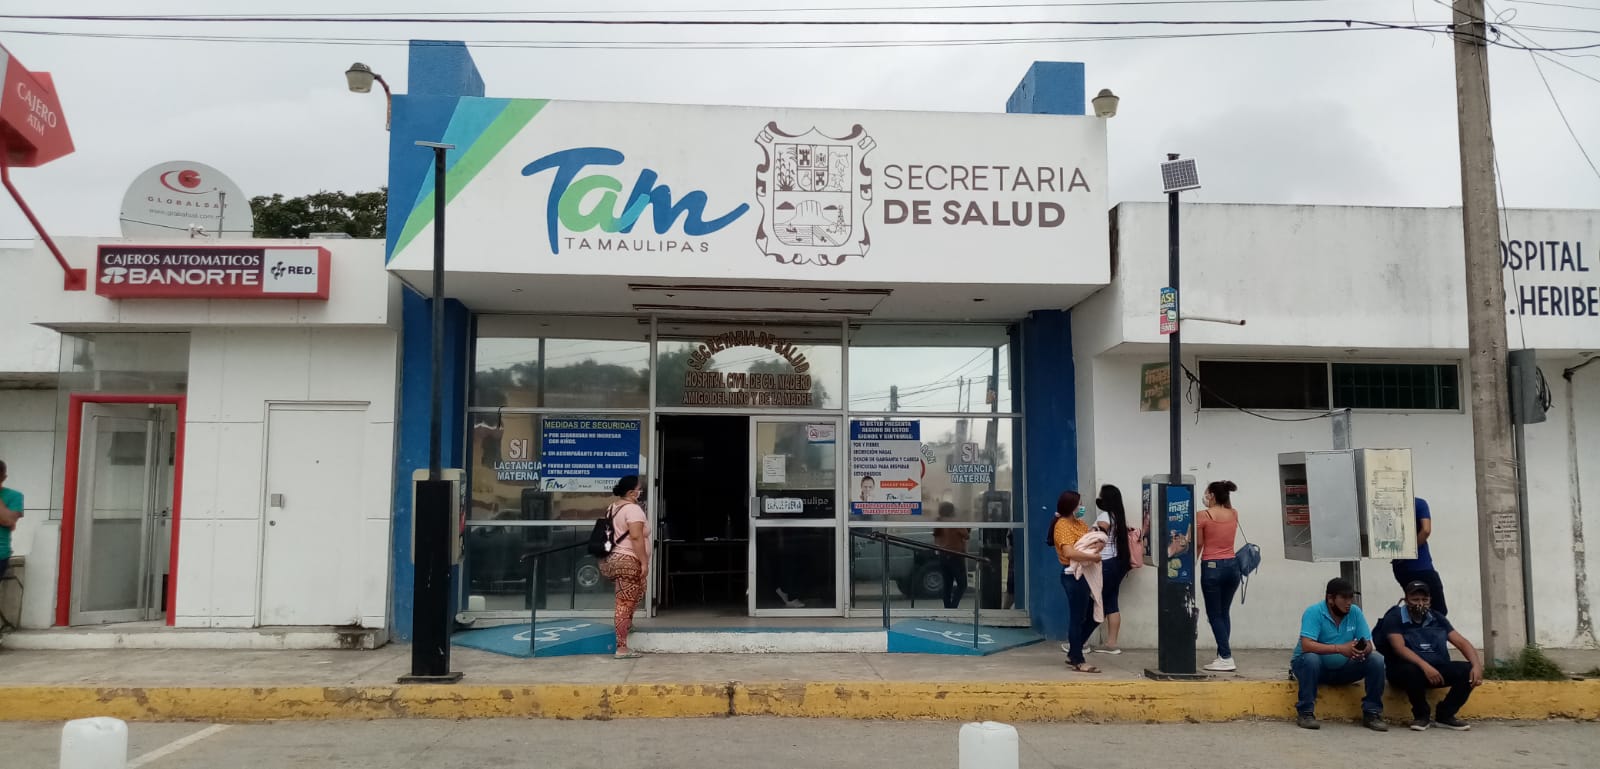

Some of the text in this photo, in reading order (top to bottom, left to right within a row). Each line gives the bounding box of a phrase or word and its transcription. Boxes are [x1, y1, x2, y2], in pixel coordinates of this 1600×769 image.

[17, 82, 57, 128] CAJERO
[27, 113, 45, 137] ATM
[883, 164, 1091, 194] SECRETARIA
[147, 196, 228, 209] GLOBALSAT
[521, 147, 749, 254] Tam
[883, 200, 1067, 229] DE SALUD
[565, 237, 709, 253] TAMAULIPAS
[104, 254, 260, 266] CAJEROS AUTOMATICOS
[1500, 240, 1589, 272] OSPITAL
[128, 268, 259, 286] BANORTE
[1519, 285, 1600, 317] HERIBE
[687, 330, 810, 374] SECRETARIA DE SALUD
[685, 371, 725, 388] HOSPITAL
[726, 372, 748, 389] CIVIL
[750, 373, 762, 389] DE
[777, 374, 811, 390] MADERO
[682, 389, 812, 405] AMIGO DEL NIÑO Y DE LA MADRE
[544, 421, 579, 429] MEDIDAS
[580, 421, 591, 429] DE
[509, 438, 529, 460] SI
[961, 443, 979, 463] SI
[494, 461, 542, 470] LACTANCIA
[947, 464, 994, 473] LACTANCIA
[496, 471, 539, 481] MATERNA
[951, 474, 991, 483] MATERNA
